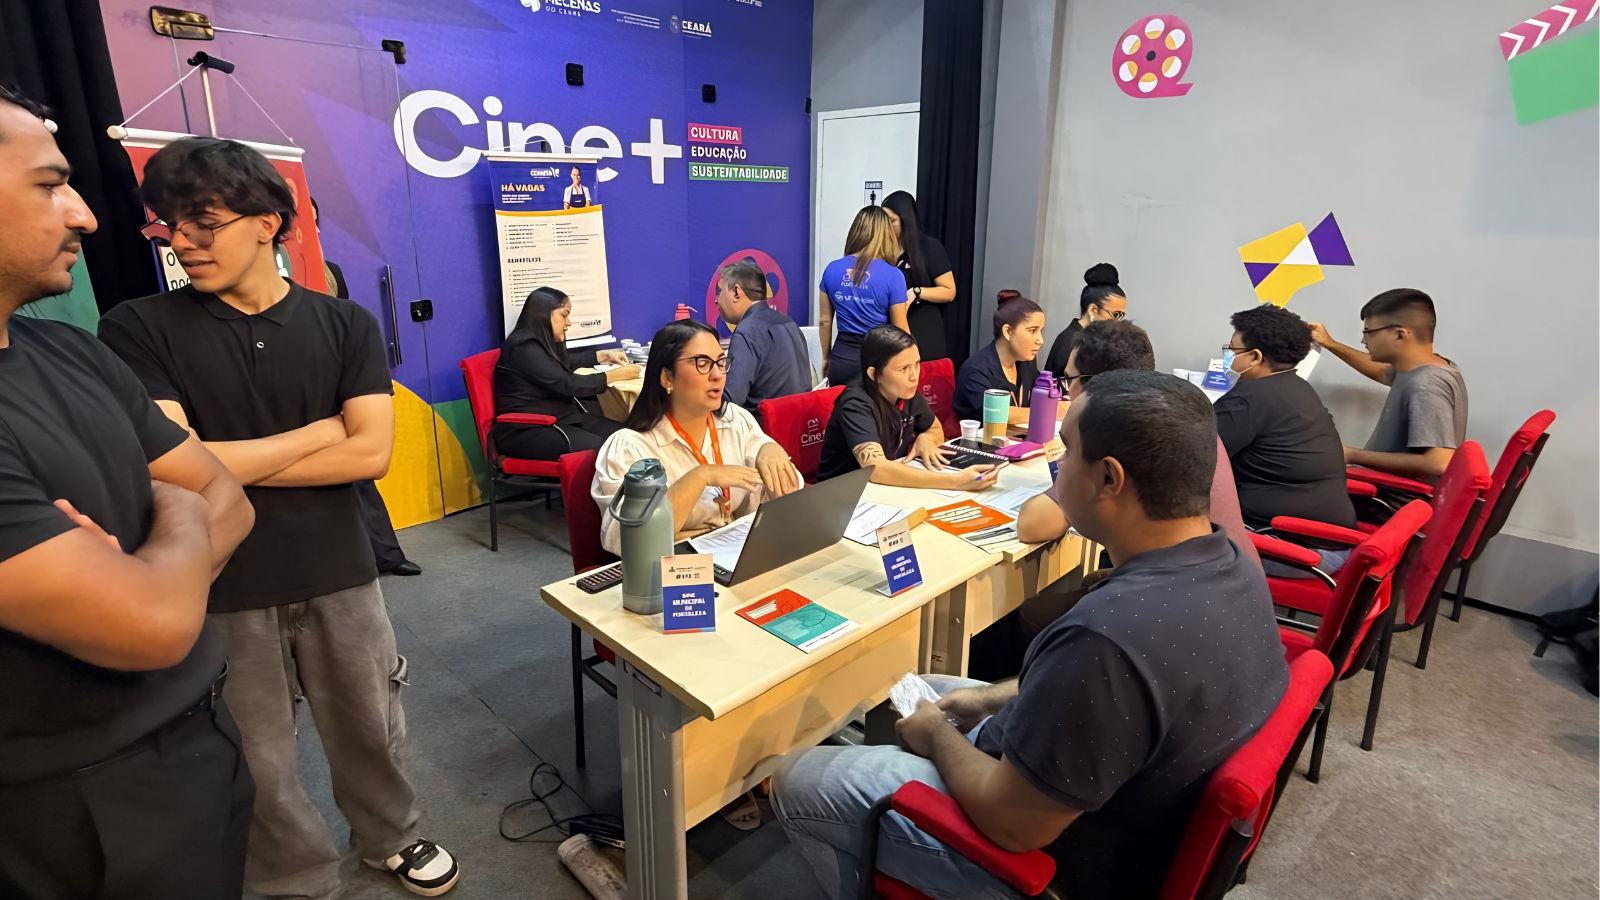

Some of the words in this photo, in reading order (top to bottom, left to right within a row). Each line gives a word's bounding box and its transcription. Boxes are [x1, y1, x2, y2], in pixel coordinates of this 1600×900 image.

[682, 20, 712, 34] CEARÁ
[691, 126, 739, 141] CULTURA
[691, 145, 747, 163] EDUCAÇÃO
[692, 165, 787, 180] SUSTENTABILIDADE
